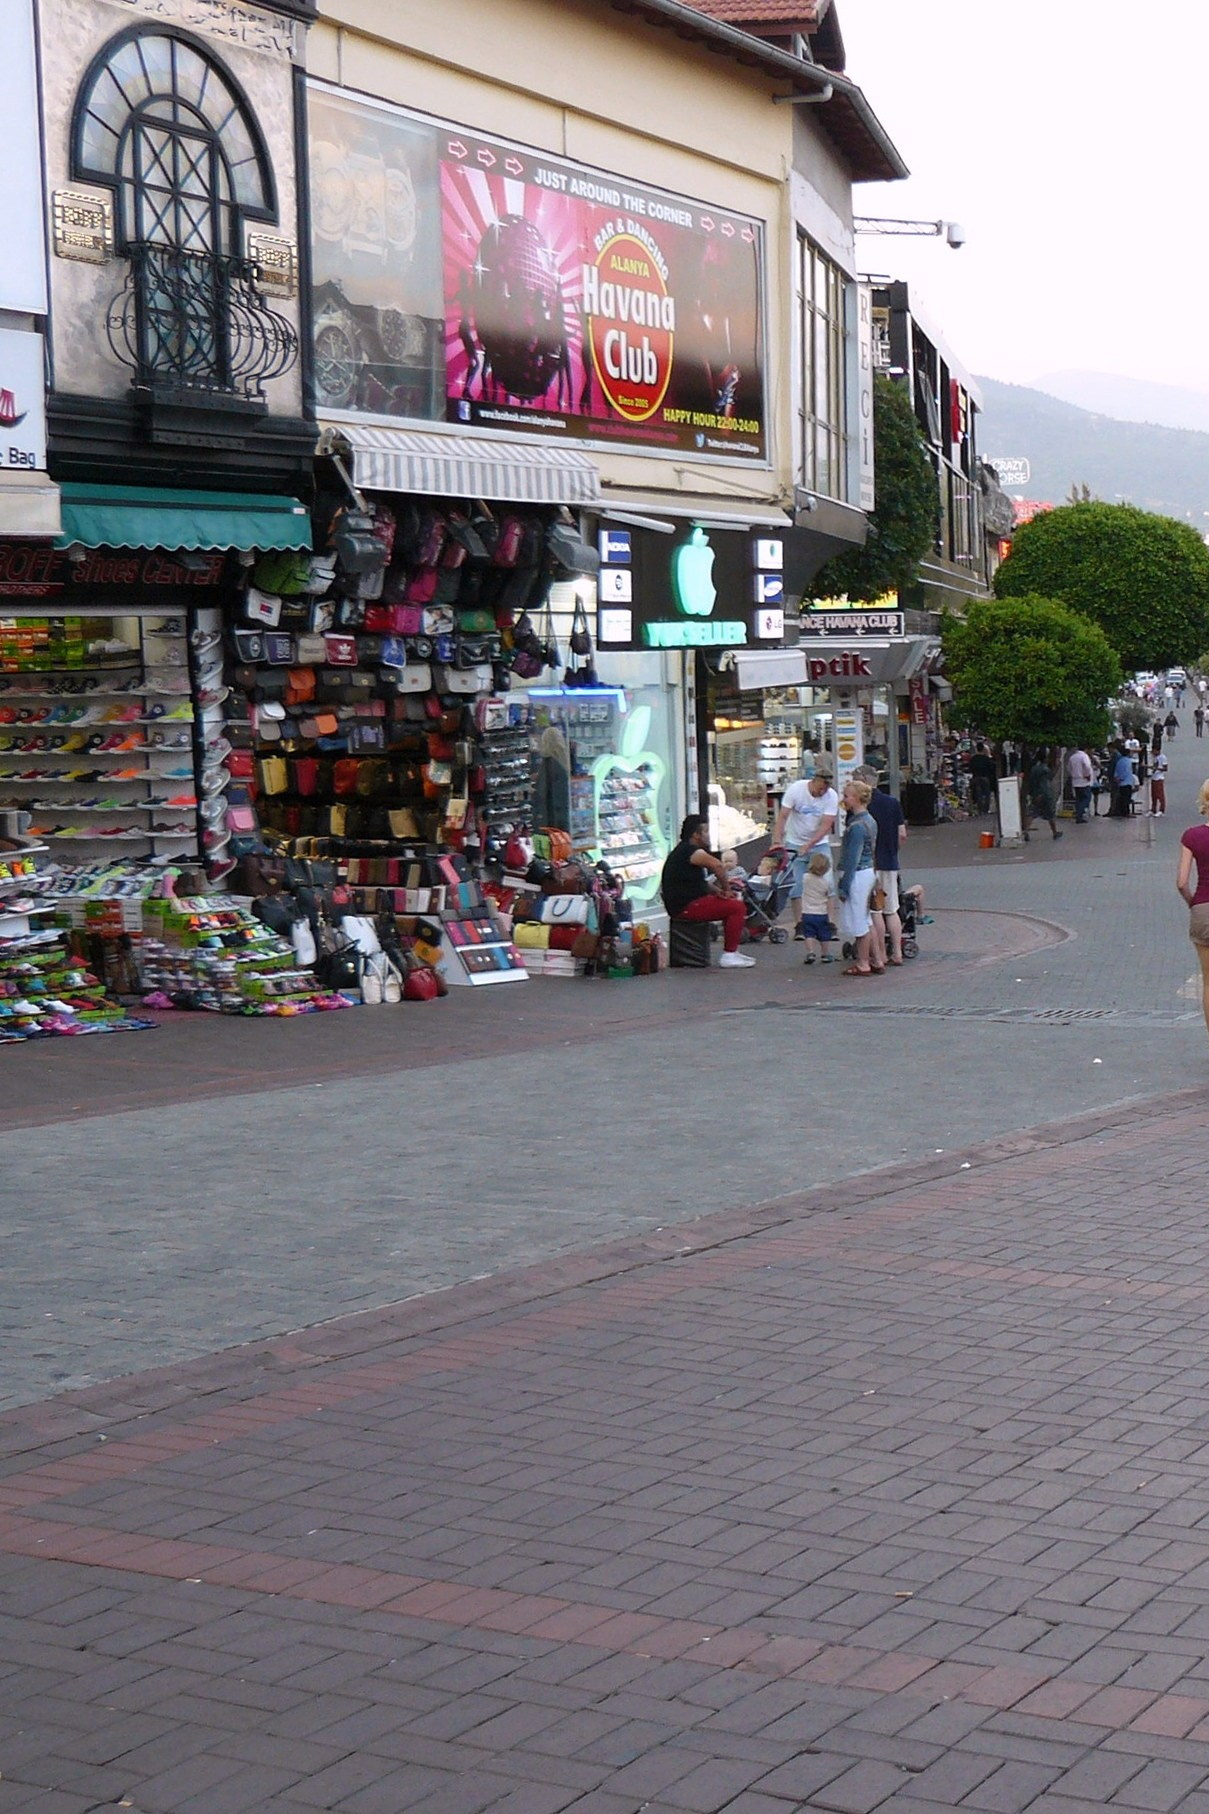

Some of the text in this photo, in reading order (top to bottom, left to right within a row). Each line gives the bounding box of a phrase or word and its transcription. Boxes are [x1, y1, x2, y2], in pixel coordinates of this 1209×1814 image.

[534, 168, 693, 228] JUST AROUND THE CORNER
[594, 218, 669, 281] BAR & DANCING
[611, 254, 651, 279] ALANYA
[583, 262, 675, 331] Havana
[603, 328, 658, 386] Club
[663, 408, 691, 424] HAPPY
[693, 412, 717, 428] HOUR
[9, 446, 36, 470] Bag
[992, 459, 1024, 471] CRAZY
[999, 472, 1027, 483] ORSE
[826, 615, 868, 628] HAVANA
[869, 615, 898, 628] CLUB
[911, 677, 925, 724] SALE
